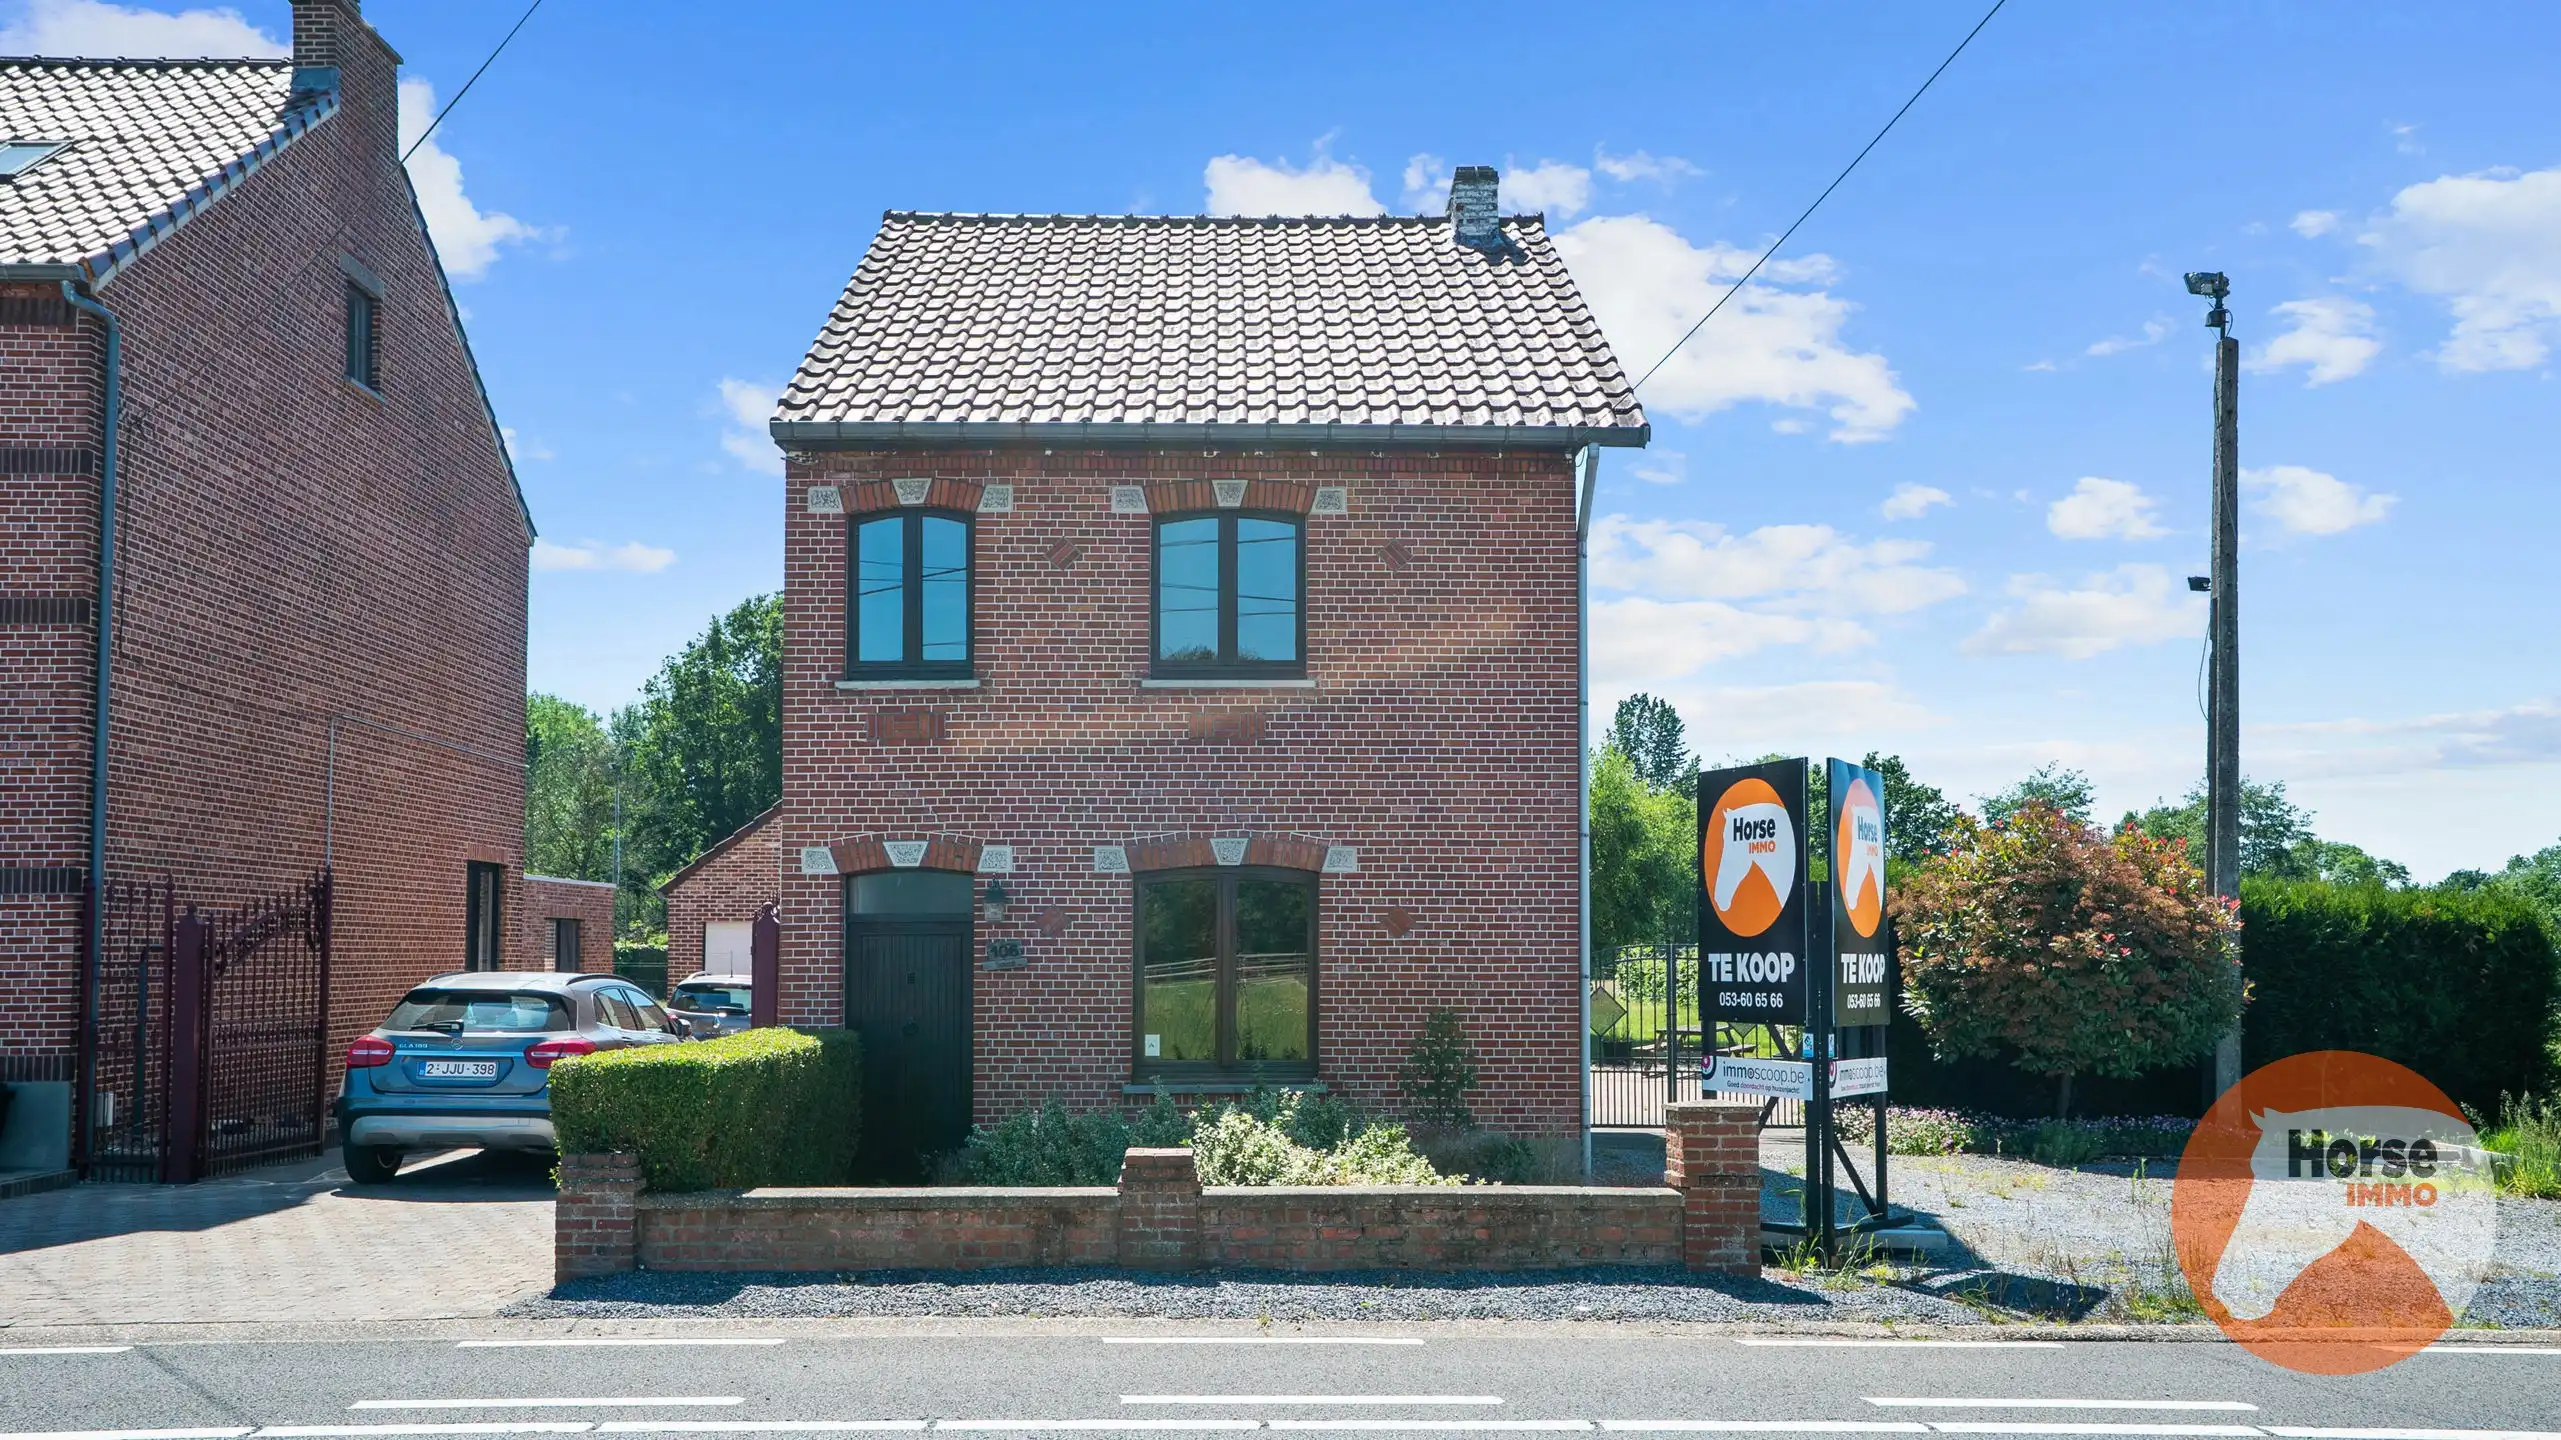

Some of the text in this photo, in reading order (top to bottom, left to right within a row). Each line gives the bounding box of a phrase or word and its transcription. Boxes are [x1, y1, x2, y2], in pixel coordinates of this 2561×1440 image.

[1733, 817, 1776, 841] Horse
[1857, 815, 1878, 842] Horse
[1748, 840, 1776, 854] IMMO
[1708, 952, 1795, 983] TE KOOP
[1841, 953, 1886, 984] TE KOOP
[1719, 992, 1784, 1008] 053-60 65 66
[1723, 1061, 1805, 1085] immoscoop.be
[1727, 1080, 1740, 1089] Goed
